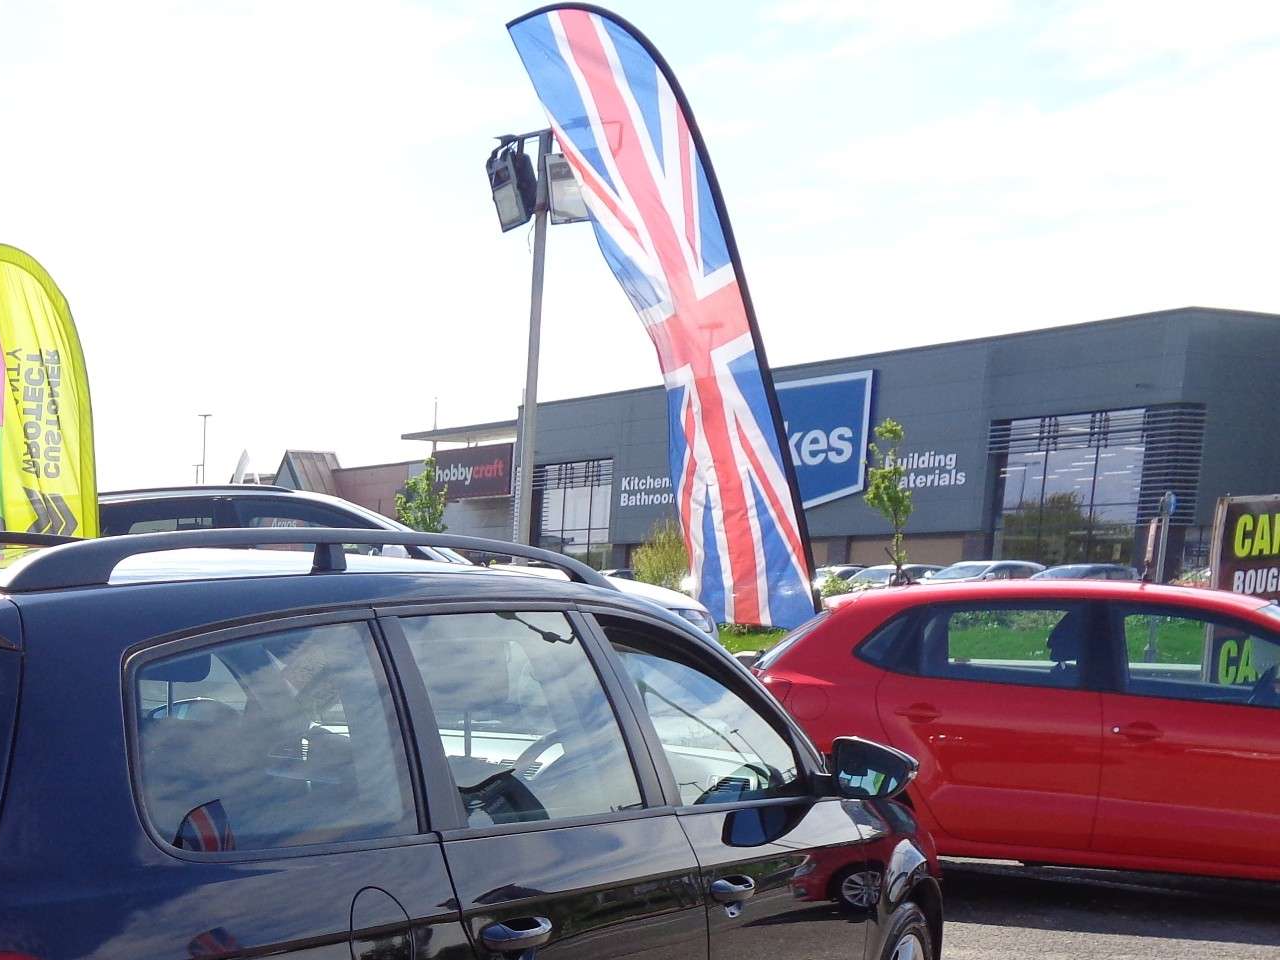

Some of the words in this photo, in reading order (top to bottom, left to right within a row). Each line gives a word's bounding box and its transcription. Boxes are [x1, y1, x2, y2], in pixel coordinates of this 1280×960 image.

[435, 459, 505, 486] hobbycraft
[621, 475, 672, 491] Kitchen
[897, 469, 967, 488] aterials
[1233, 568, 1280, 595] BOUG
[1218, 640, 1258, 685] CA
